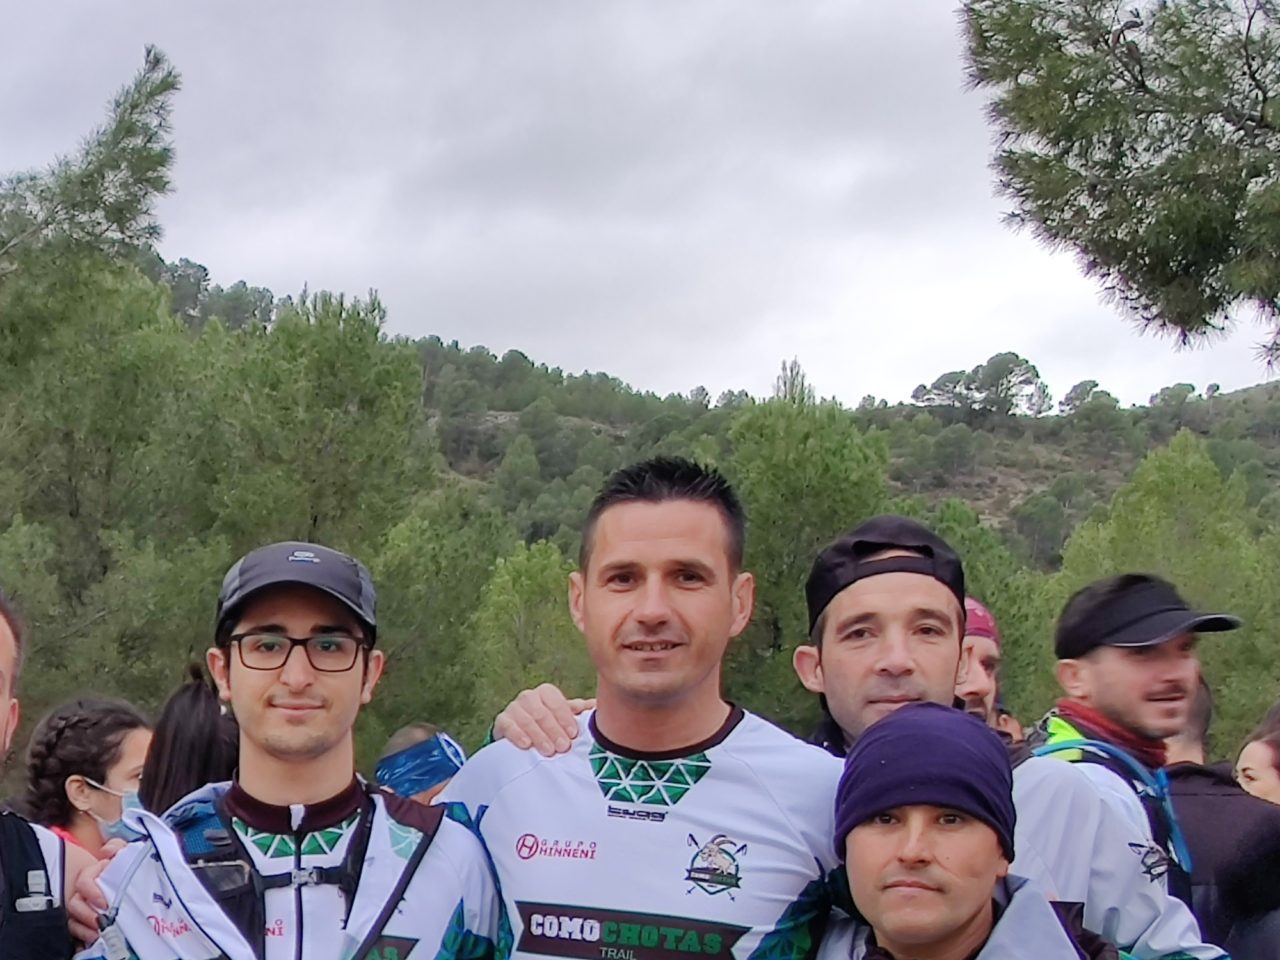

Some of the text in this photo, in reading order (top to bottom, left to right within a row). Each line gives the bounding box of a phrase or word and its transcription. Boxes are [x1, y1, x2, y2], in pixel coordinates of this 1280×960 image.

[541, 838, 597, 850] GRUPO
[539, 846, 597, 860] HINNENI
[529, 913, 723, 955] COMOCHOTAS
[599, 946, 638, 960] TRAIL
